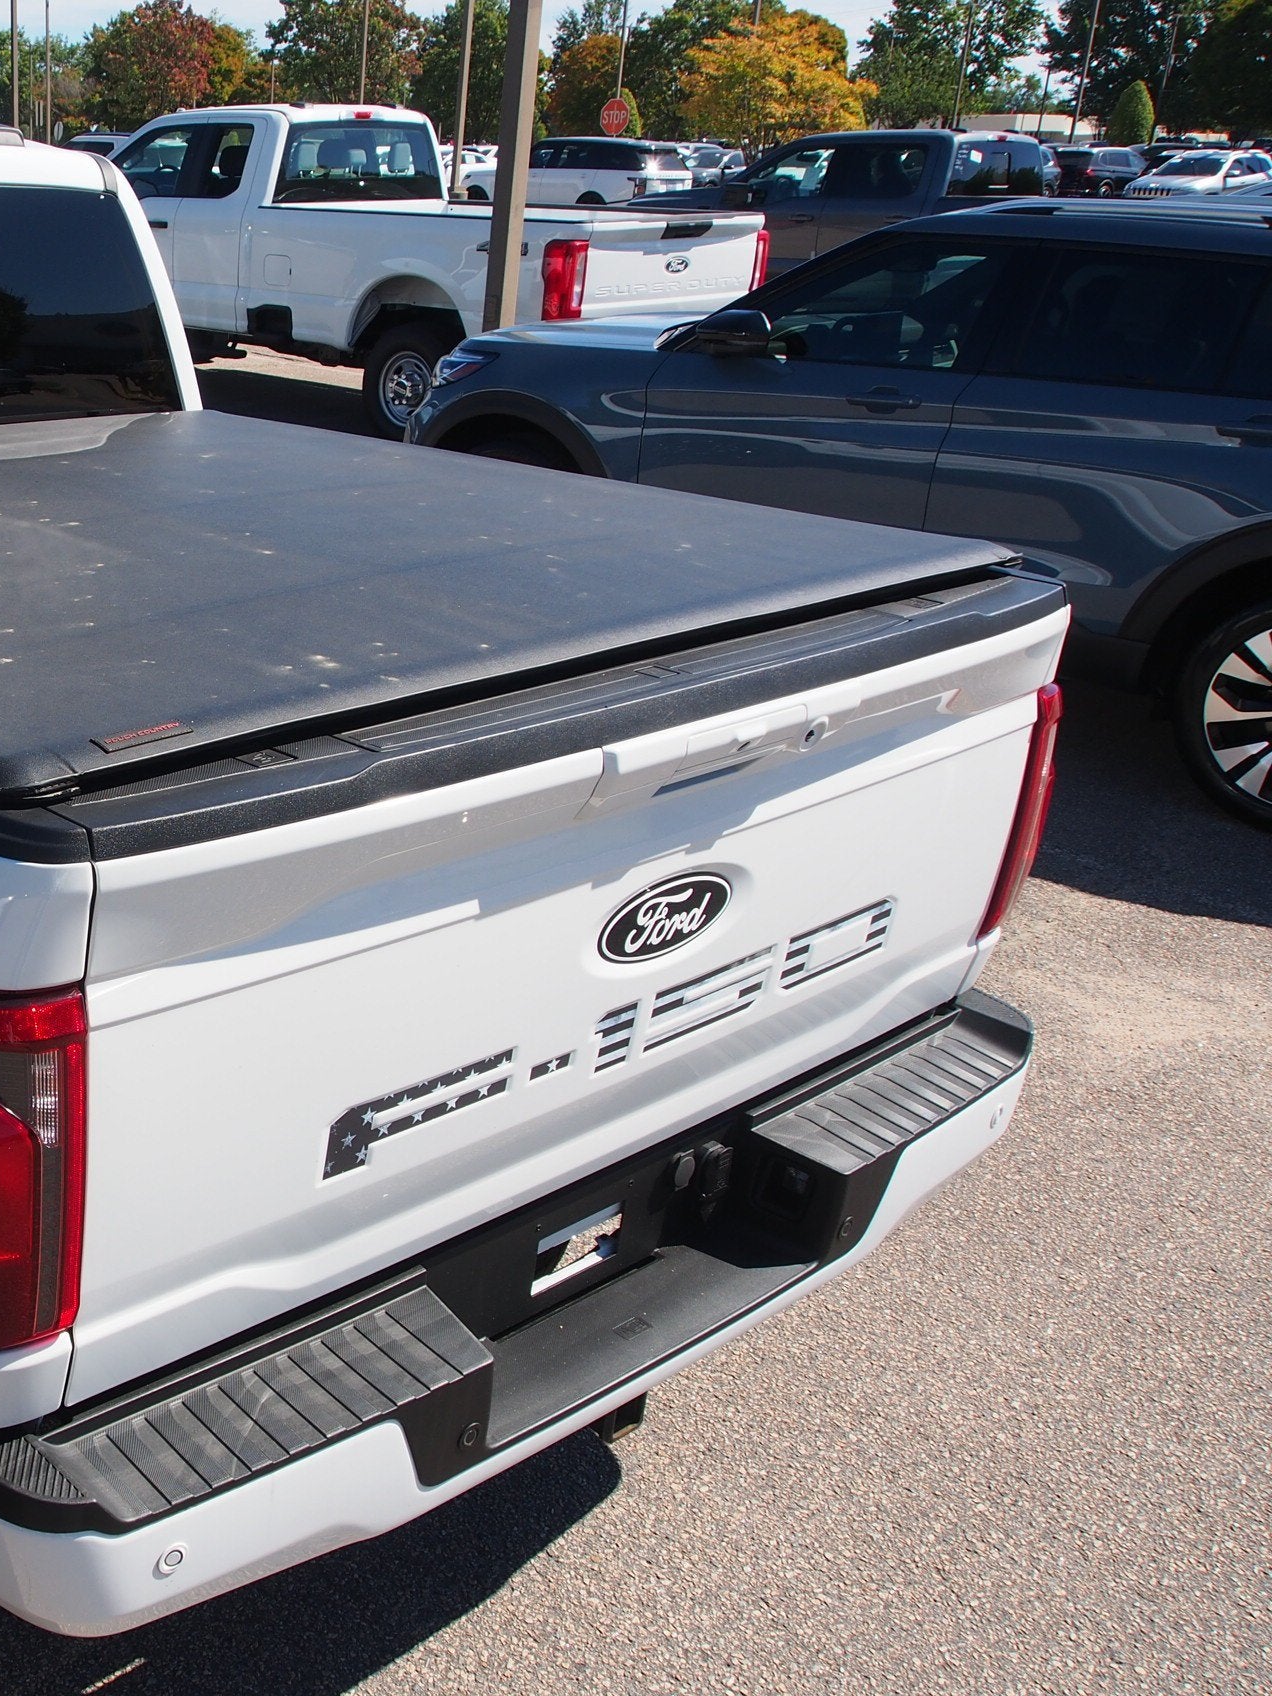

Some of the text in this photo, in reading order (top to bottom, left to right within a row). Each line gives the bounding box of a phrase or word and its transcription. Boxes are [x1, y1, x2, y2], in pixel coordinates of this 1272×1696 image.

[603, 110, 627, 124] STOP
[667, 257, 688, 273] Ford
[595, 275, 745, 298] SUPER DUTY
[104, 722, 180, 744] ROUGH COUNTRY
[624, 888, 712, 953] Ford
[319, 897, 896, 1184] F-150
